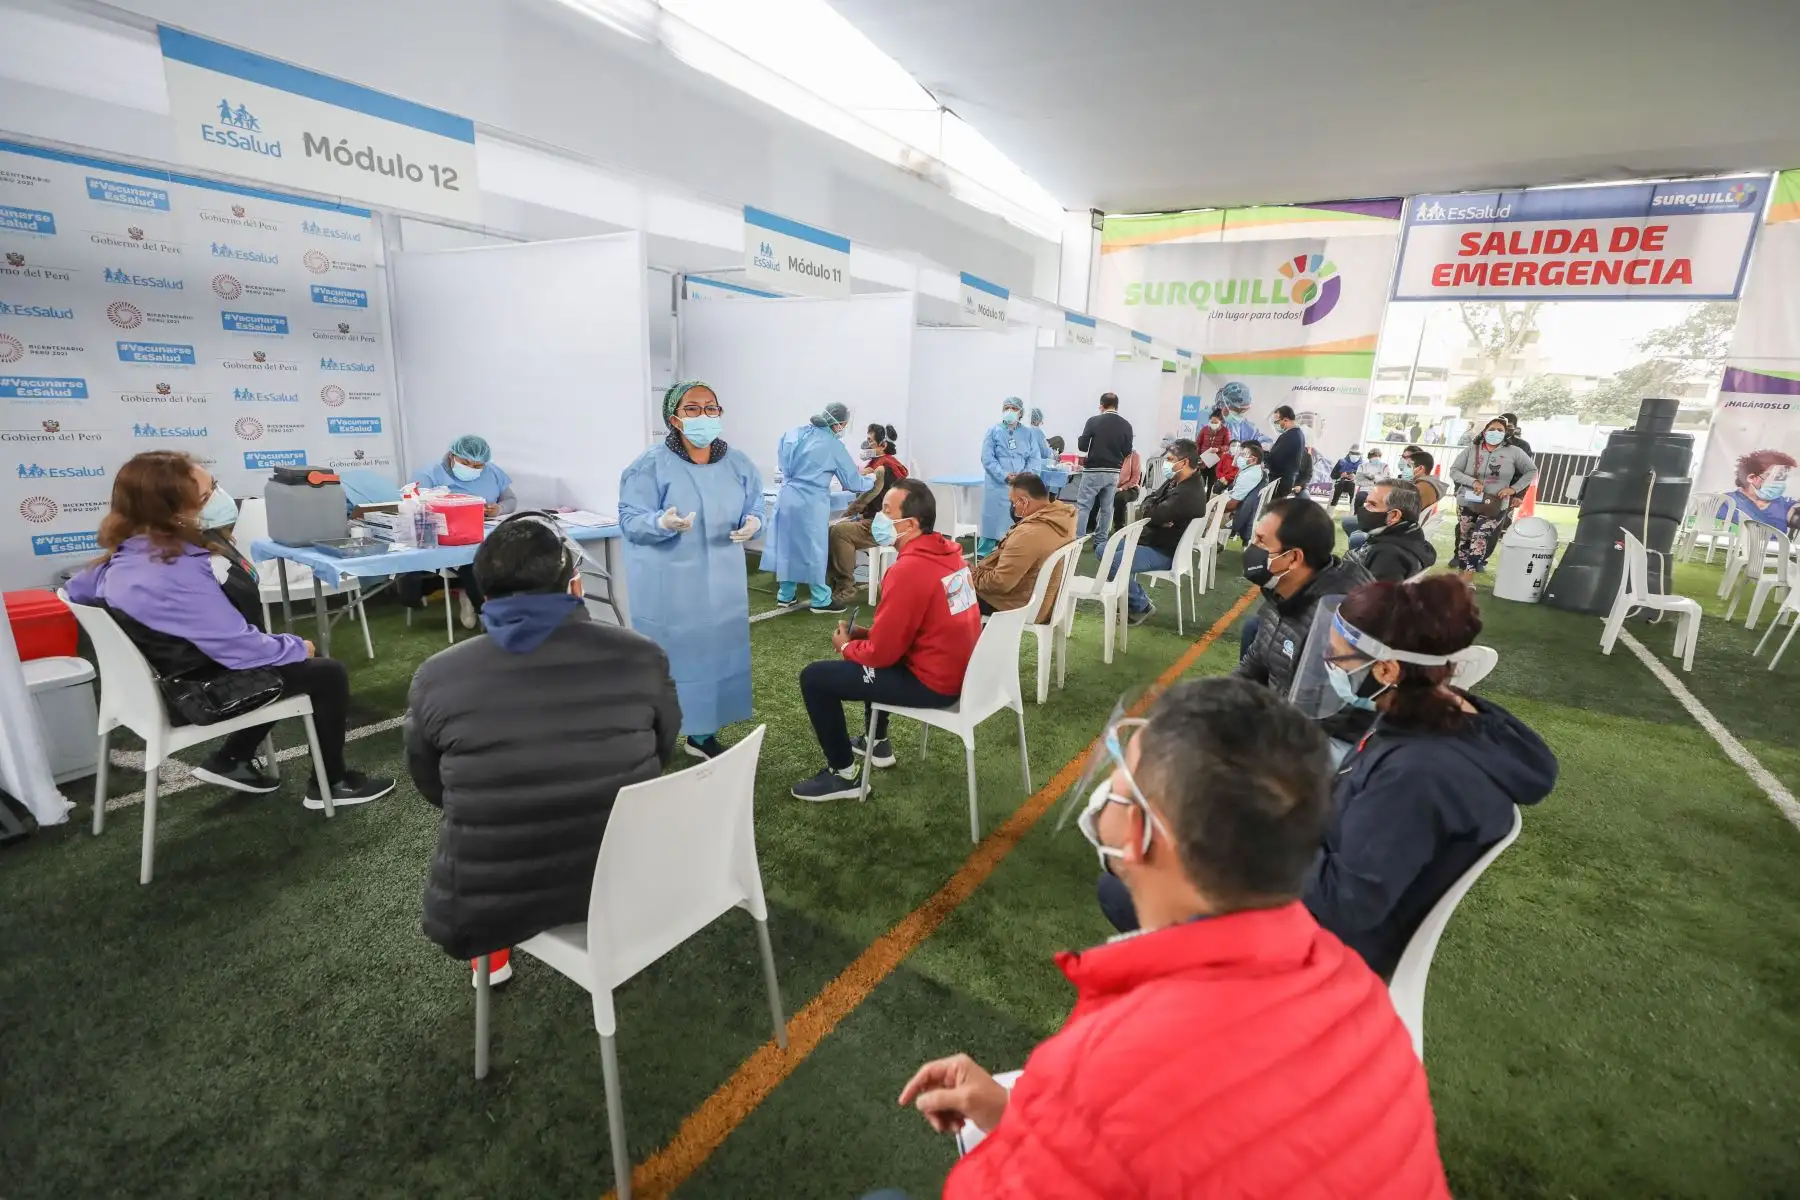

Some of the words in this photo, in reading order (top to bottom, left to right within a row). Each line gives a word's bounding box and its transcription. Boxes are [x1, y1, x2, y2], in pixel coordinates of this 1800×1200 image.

[201, 124, 282, 158] EsSalud
[302, 131, 424, 182] Módulo
[429, 163, 460, 192] 12
[0, 170, 51, 183] CENTENARIO
[89, 180, 166, 200] #Vacunarse
[104, 190, 156, 207] EsSalud
[0, 208, 50, 222] unarse
[1448, 204, 1511, 220] EsSalud
[0, 217, 38, 230] Salud
[200, 212, 242, 226] Gobierno
[244, 218, 256, 228] del
[324, 228, 361, 242] EsSalud
[1458, 228, 1598, 256] SALIDA
[1608, 225, 1669, 252] DE
[90, 235, 139, 248] Gobierno
[142, 242, 157, 251] del
[236, 250, 278, 265] EsSalud
[754, 256, 780, 272] EsSalud
[788, 255, 830, 280] Módulo
[832, 268, 842, 283] 11
[24, 268, 41, 278] del
[1432, 258, 1692, 286] EMERGENCIA
[132, 276, 184, 290] EsSalud
[314, 287, 364, 299] #Vacunarse
[324, 296, 358, 305] EsSalud
[14, 304, 74, 320] EsSalud
[978, 302, 998, 320] Módulo
[1208, 310, 1224, 320] ¡Un
[1226, 310, 1249, 322] lugar
[1250, 312, 1271, 322] para
[1274, 310, 1302, 320] todos!
[224, 314, 286, 325] #Vacunarse
[236, 322, 276, 332] EsSalud
[312, 332, 346, 340] Gobierno
[120, 344, 192, 354] #Vacunarse
[134, 352, 181, 362] EsSalud
[223, 362, 262, 370] Gobierno
[264, 362, 277, 370] del
[340, 364, 375, 372] EsSalud
[0, 378, 84, 388] #Vacunarse
[16, 387, 72, 396] EsSalud
[257, 393, 298, 402] EsSalud
[120, 394, 166, 402] Gobierno
[2, 433, 55, 441] Gobierno
[58, 433, 74, 441] del
[160, 426, 208, 438] EsSalud
[246, 452, 304, 460] #Vacunarse
[257, 459, 296, 467] EsSalud
[49, 466, 105, 478] EsSalud
[35, 534, 97, 544] #Vacuna
